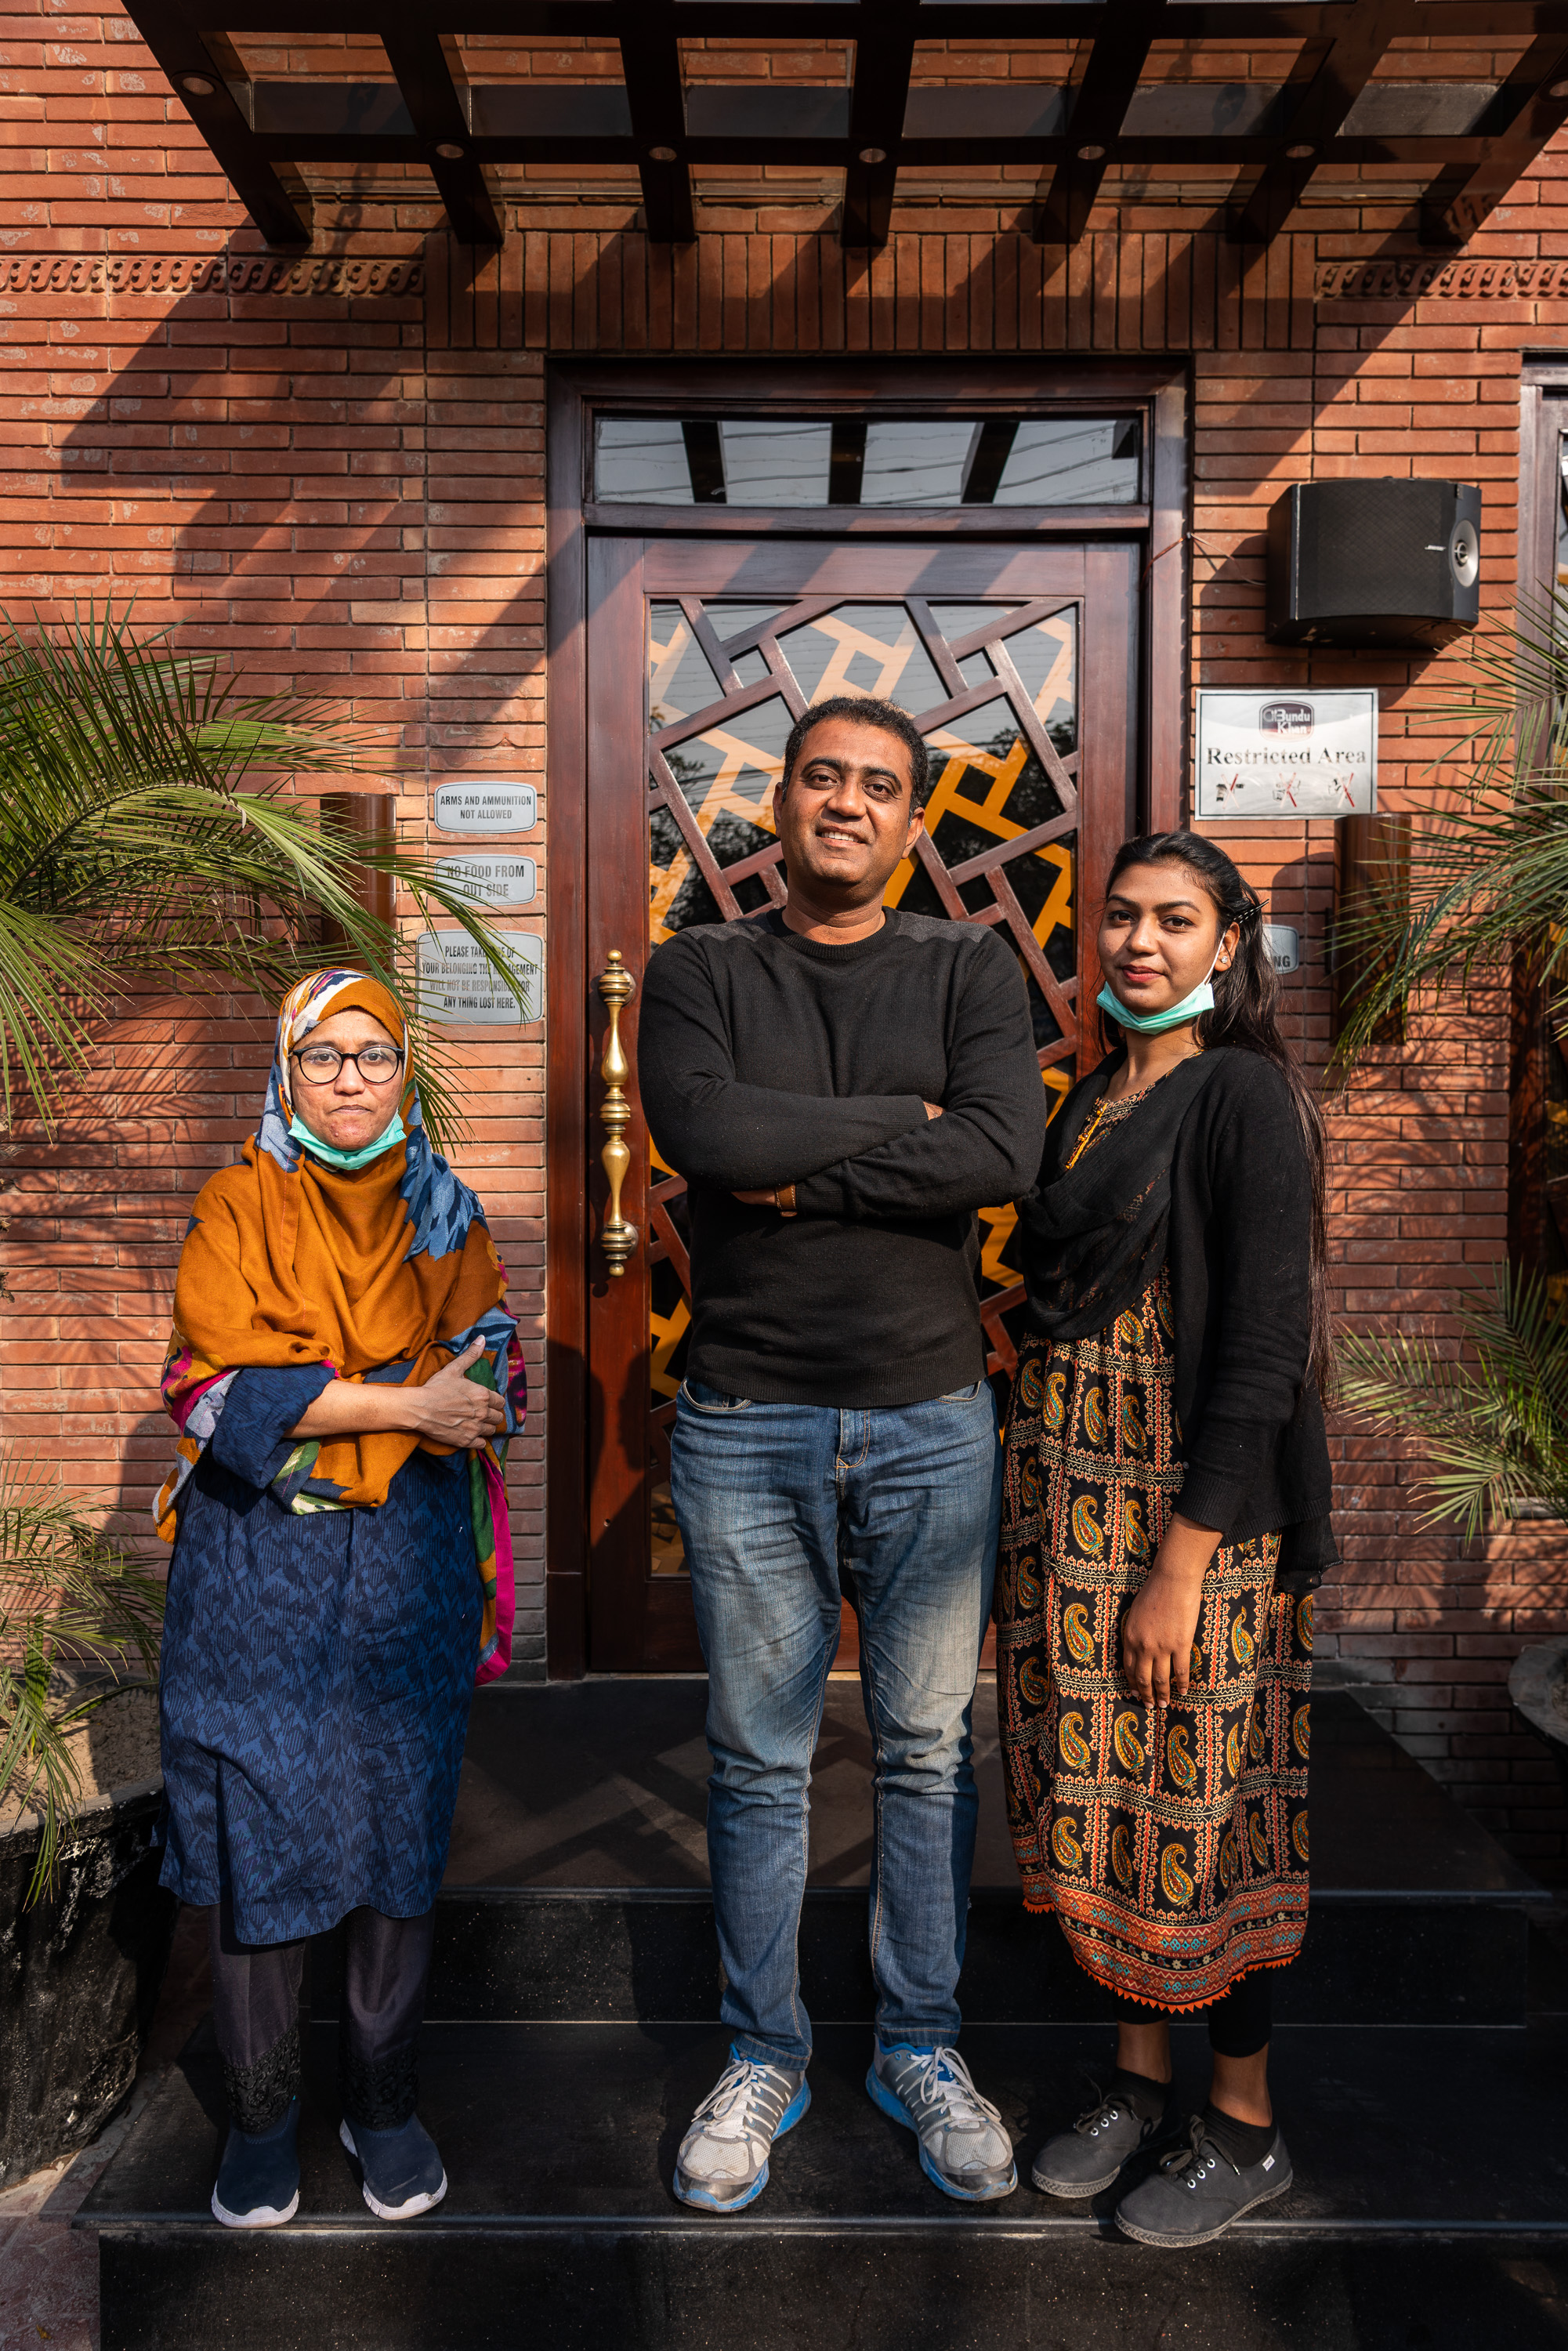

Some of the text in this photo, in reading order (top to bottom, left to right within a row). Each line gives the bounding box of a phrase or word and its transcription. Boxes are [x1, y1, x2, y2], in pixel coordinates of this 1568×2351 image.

[1276, 708, 1311, 722] Bundu
[1207, 747, 1367, 765] Restricted Area
[440, 795, 531, 806] ARMS AND AMMUNITION
[460, 810, 512, 819] NOT ALLOWED
[447, 865, 524, 878] NO FOOD FROM
[463, 884, 509, 897] OUT SIDE
[445, 946, 469, 958] PLEASE
[506, 947, 516, 958] OF
[422, 962, 440, 974] YOUR
[441, 962, 477, 975] BELONGING
[479, 963, 491, 975] THE
[430, 980, 445, 991] WILL
[447, 980, 460, 991] NOT
[462, 980, 470, 991] BE
[444, 997, 516, 1009] ANY THING LOST HERE.
